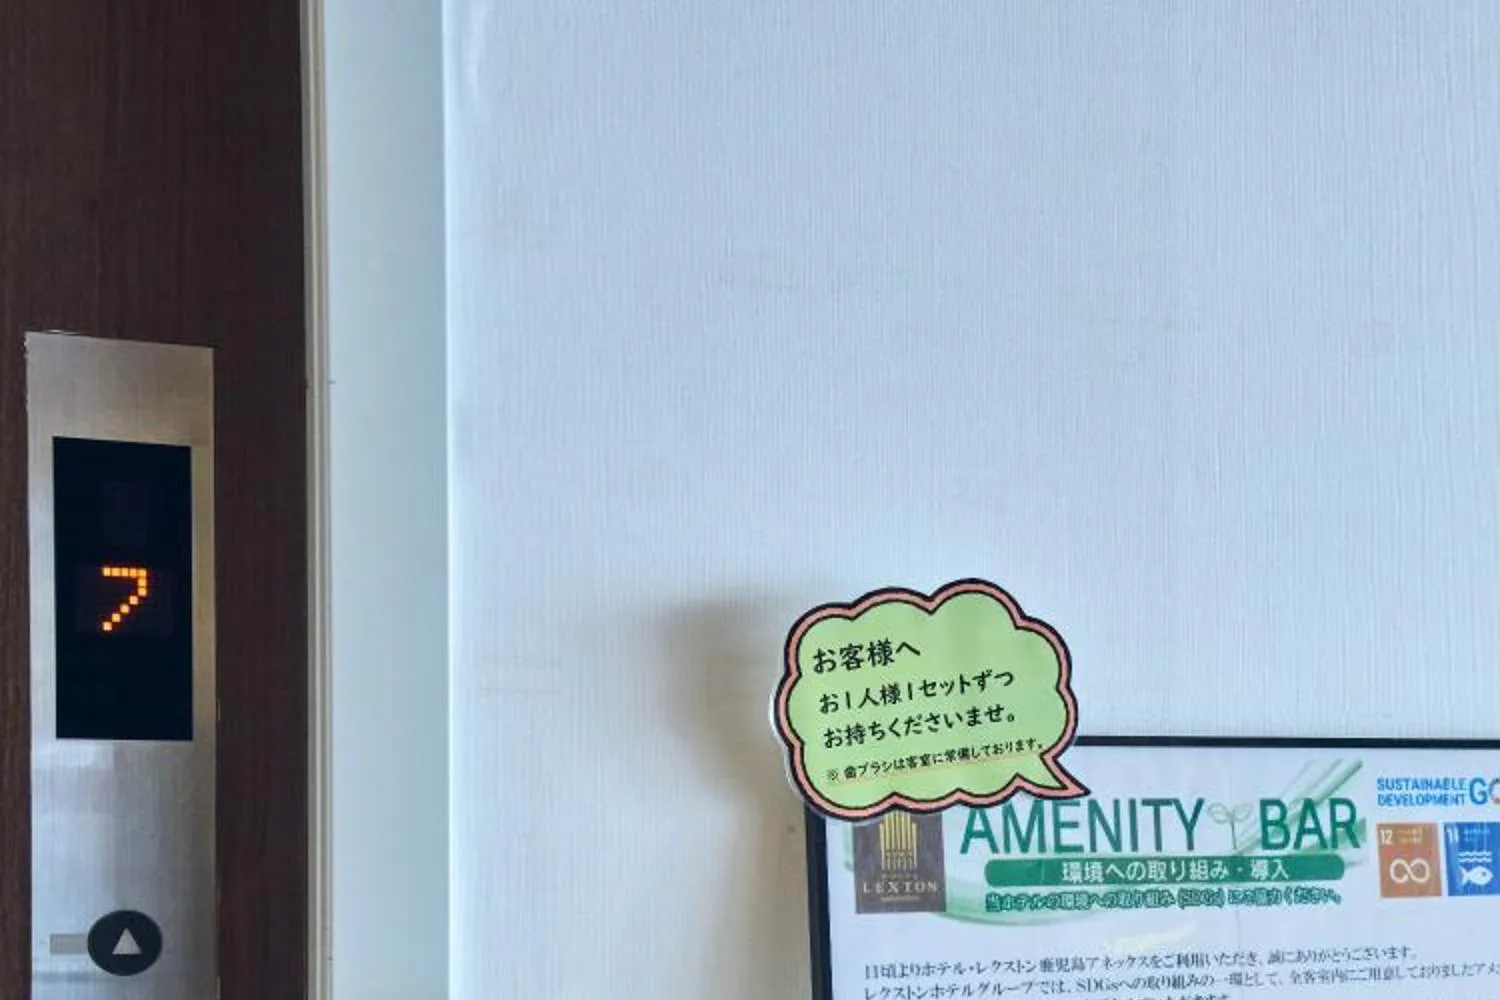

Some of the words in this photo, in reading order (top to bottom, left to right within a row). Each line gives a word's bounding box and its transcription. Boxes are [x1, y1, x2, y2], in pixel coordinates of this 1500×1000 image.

[103, 567, 147, 631] 7
[812, 638, 921, 674] お客様へ
[823, 703, 1015, 749] お持ちくださいませ。
[1377, 777, 1466, 791] SUSTAINABLE
[1377, 793, 1466, 807] DEVELOPMENT
[960, 797, 1205, 855] AMENITY
[1259, 798, 1362, 851] BAR
[1379, 829, 1393, 845] 12
[863, 880, 937, 894] LEXTON
